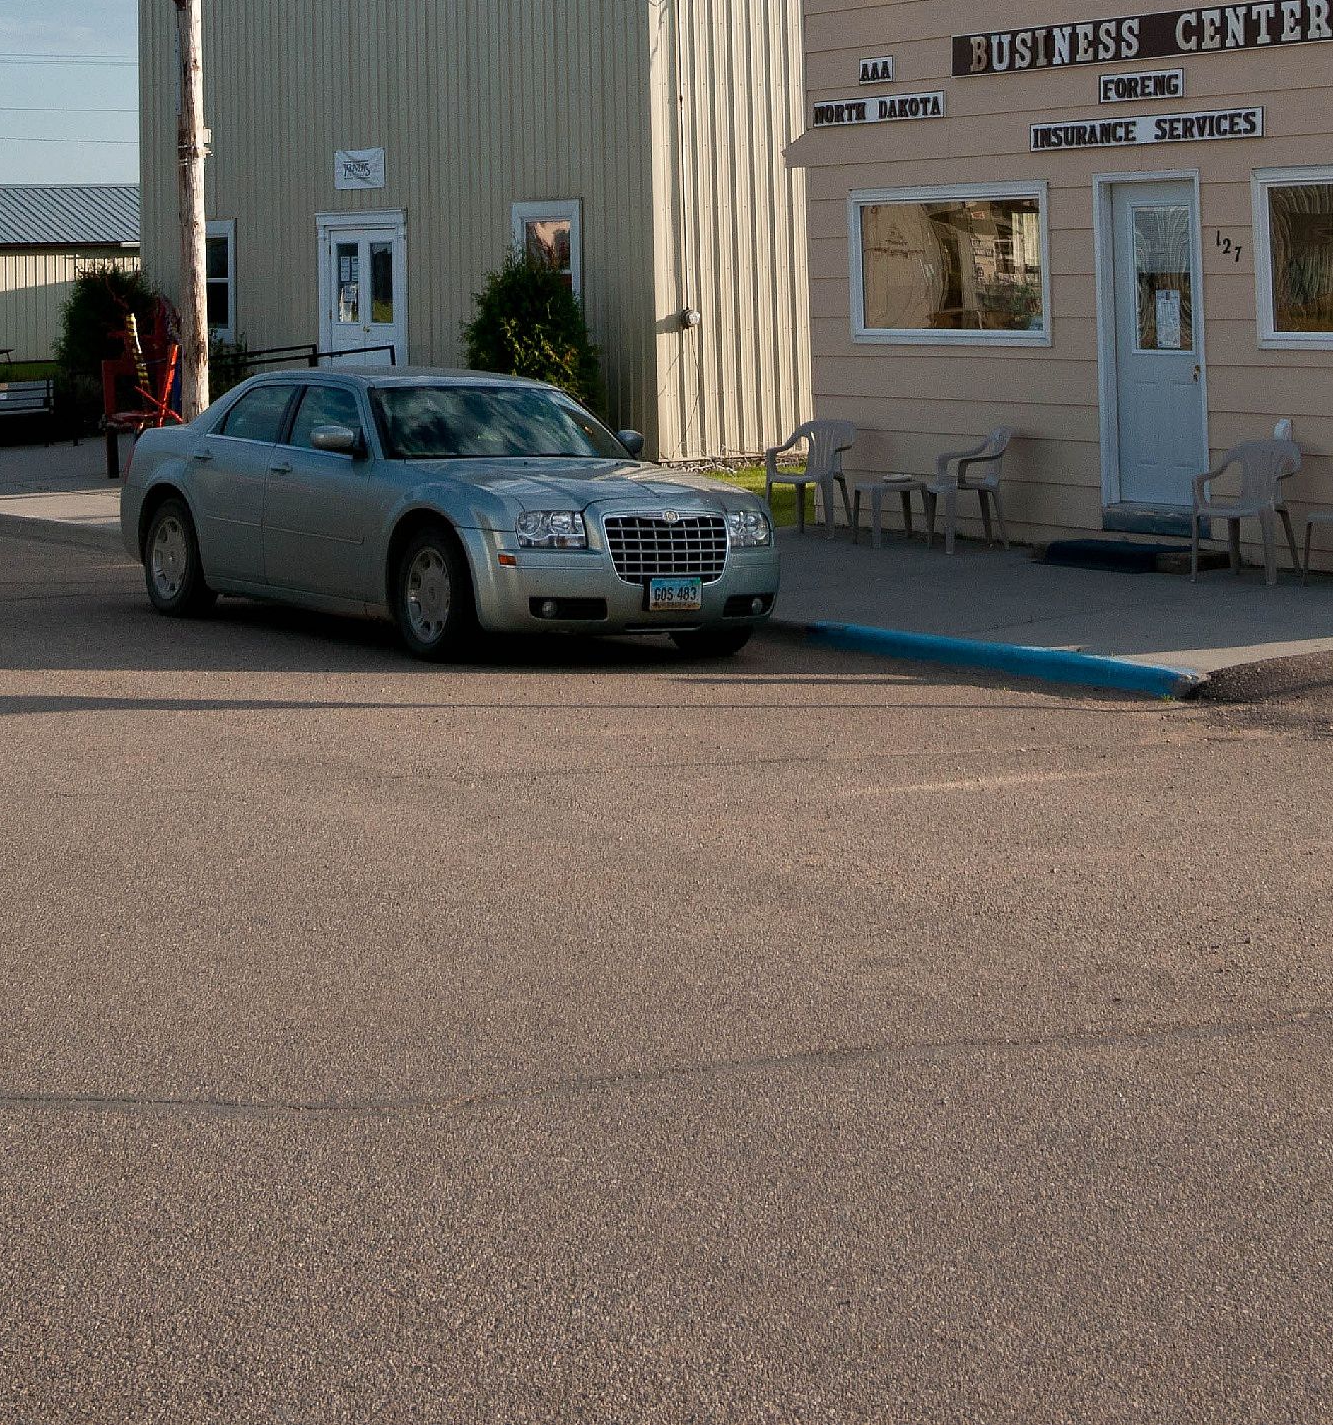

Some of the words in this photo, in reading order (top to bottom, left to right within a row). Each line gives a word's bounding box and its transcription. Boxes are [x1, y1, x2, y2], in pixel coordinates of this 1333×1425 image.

[969, 17, 1141, 73] BUSINESS
[859, 60, 890, 82] AAA
[1102, 74, 1180, 101] FORENG
[813, 101, 867, 124] NORTH
[878, 95, 941, 119] DAKOTA
[1033, 121, 1137, 149] INSURANCE
[1154, 111, 1256, 140] SERVICES
[1216, 230, 1243, 263] 127
